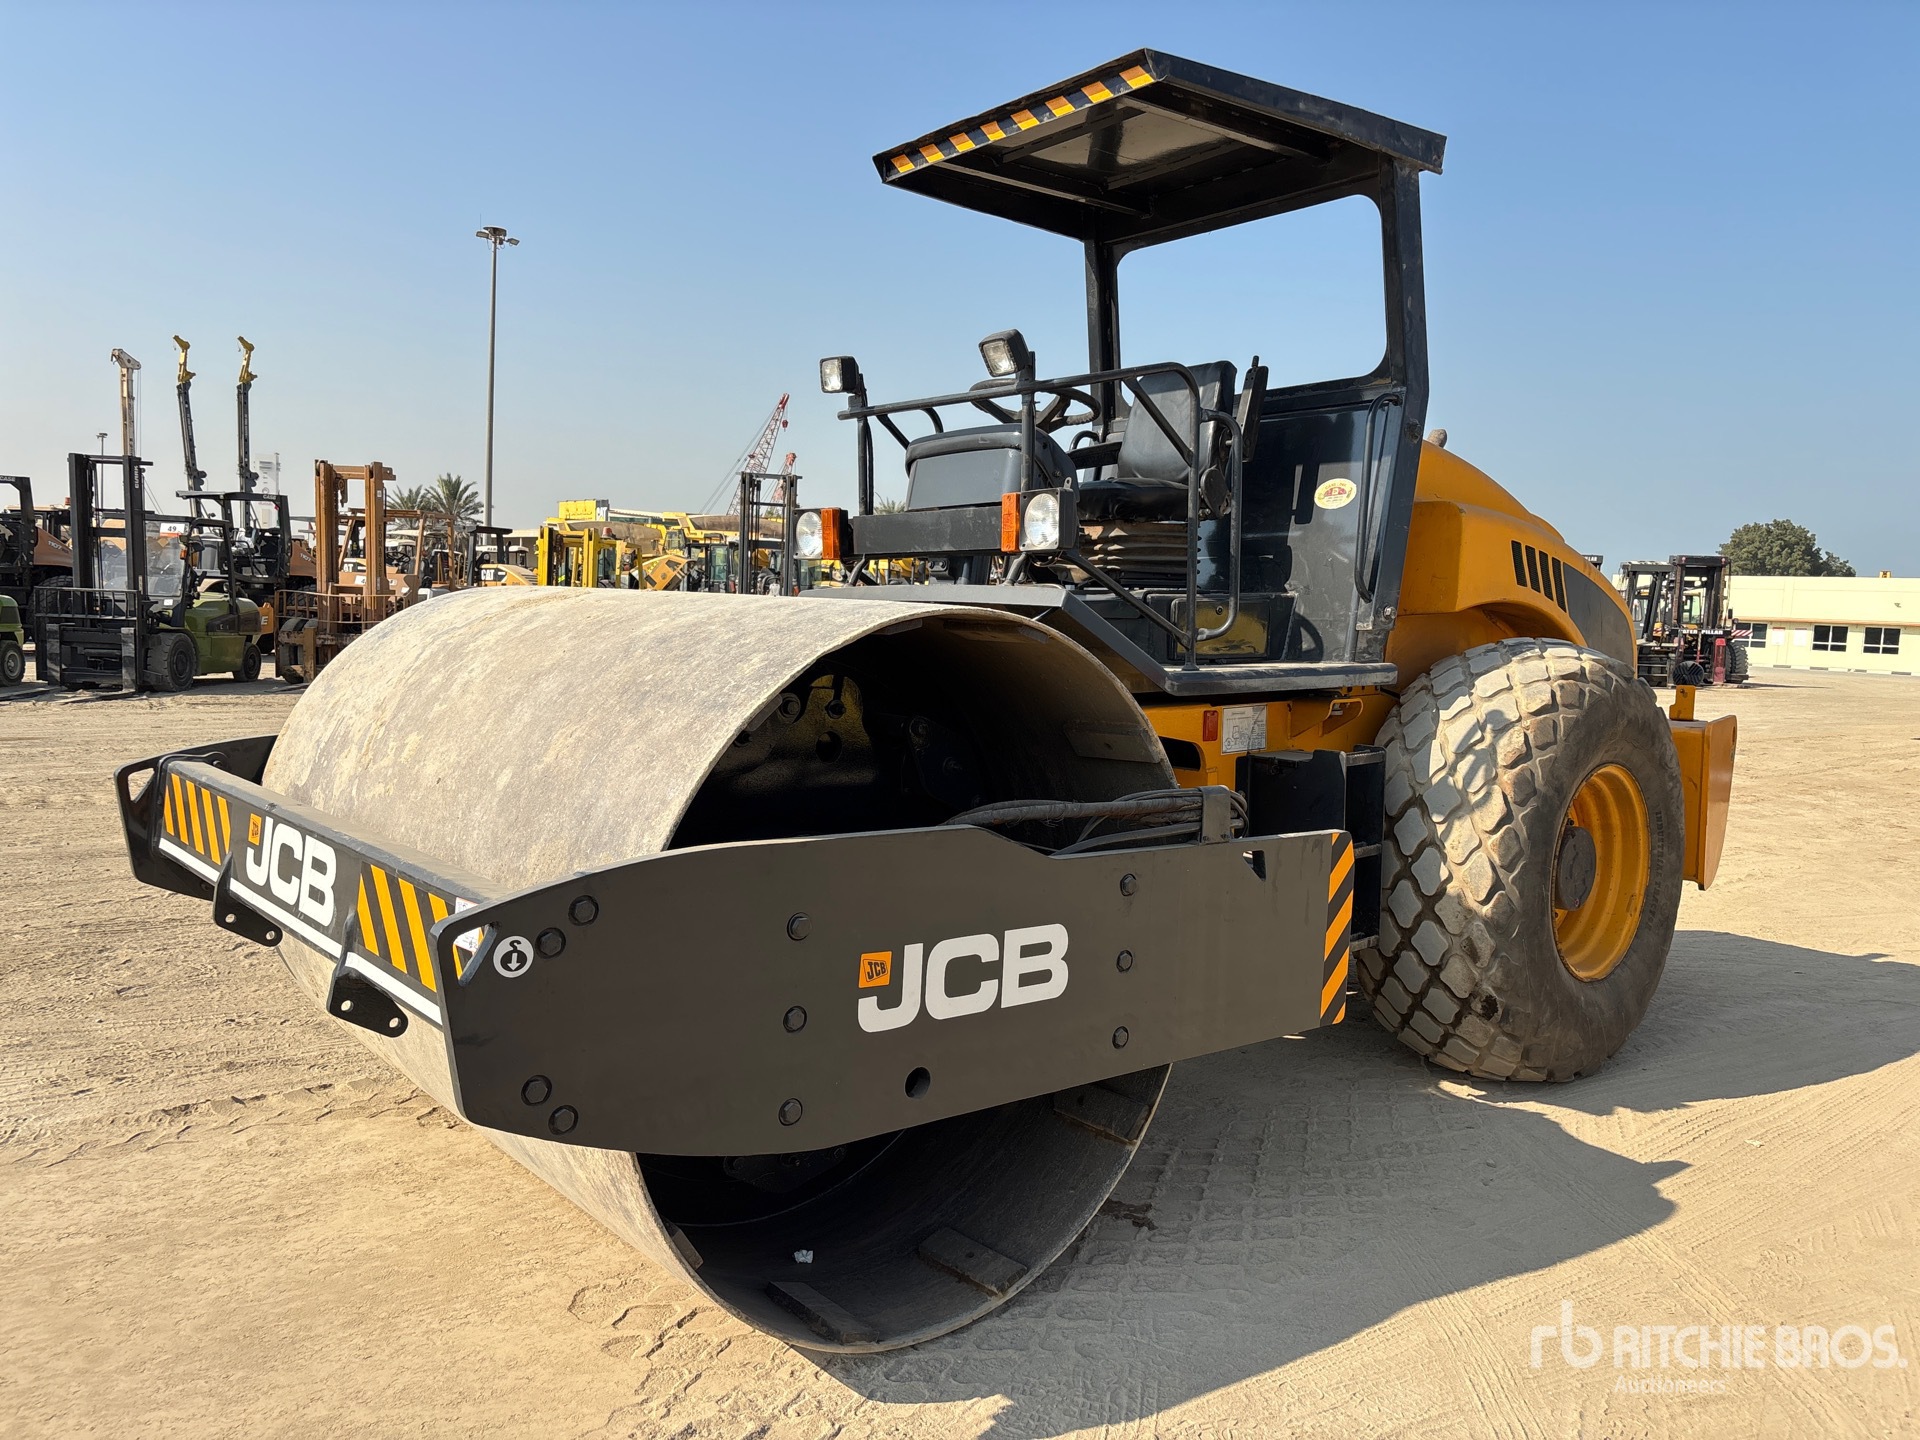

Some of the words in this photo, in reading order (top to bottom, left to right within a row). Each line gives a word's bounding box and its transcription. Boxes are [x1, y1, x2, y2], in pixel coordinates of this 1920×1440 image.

[481, 569, 495, 580] CAT
[246, 816, 337, 927] JCB
[858, 923, 1069, 1033] JCB
[866, 960, 887, 982] JCB
